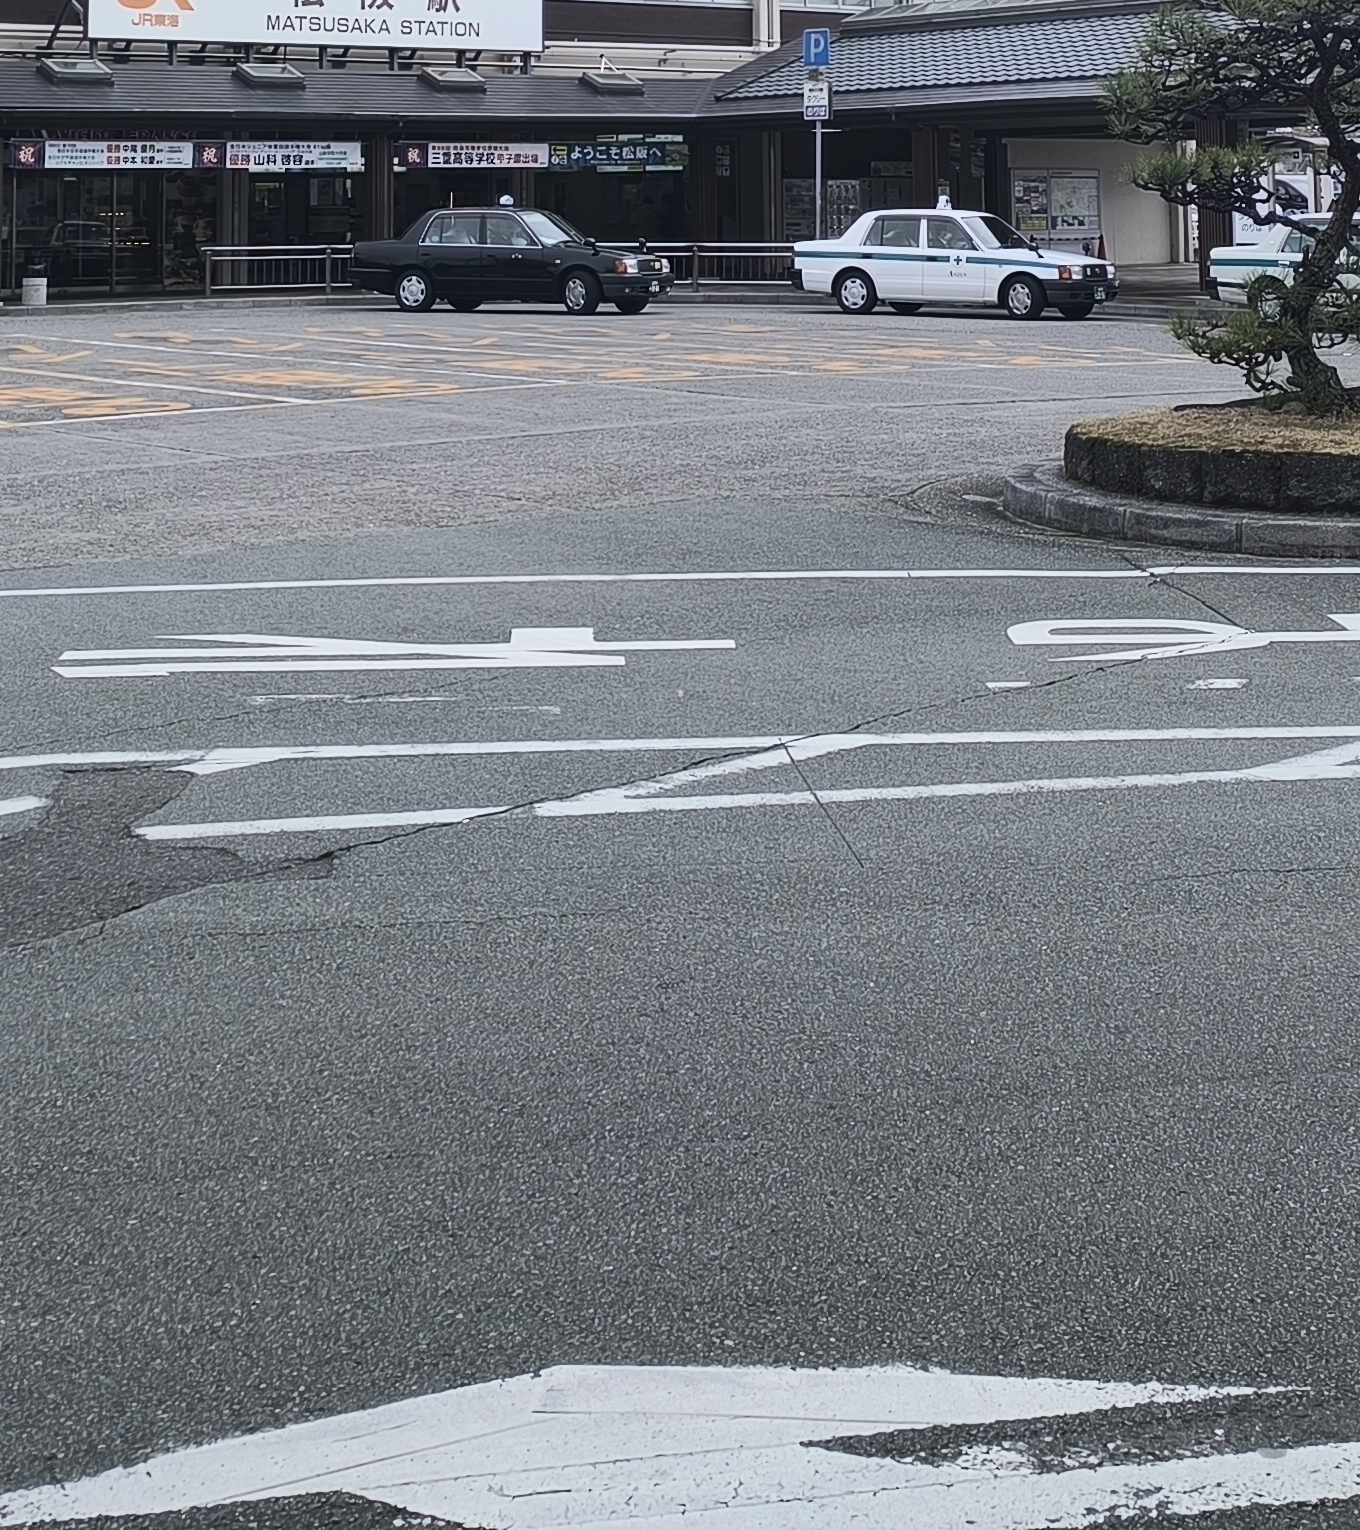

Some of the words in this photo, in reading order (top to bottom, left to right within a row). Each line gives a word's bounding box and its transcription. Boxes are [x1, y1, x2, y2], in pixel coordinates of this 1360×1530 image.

[131, 12, 180, 28] JR東海
[266, 14, 391, 35] MATSUSAKA
[400, 20, 481, 38] STATION
[810, 33, 825, 63] P
[18, 146, 36, 163] 祝
[202, 147, 218, 163] 祝
[407, 147, 421, 163] 祝
[570, 145, 662, 160] ようこそ松阪へ
